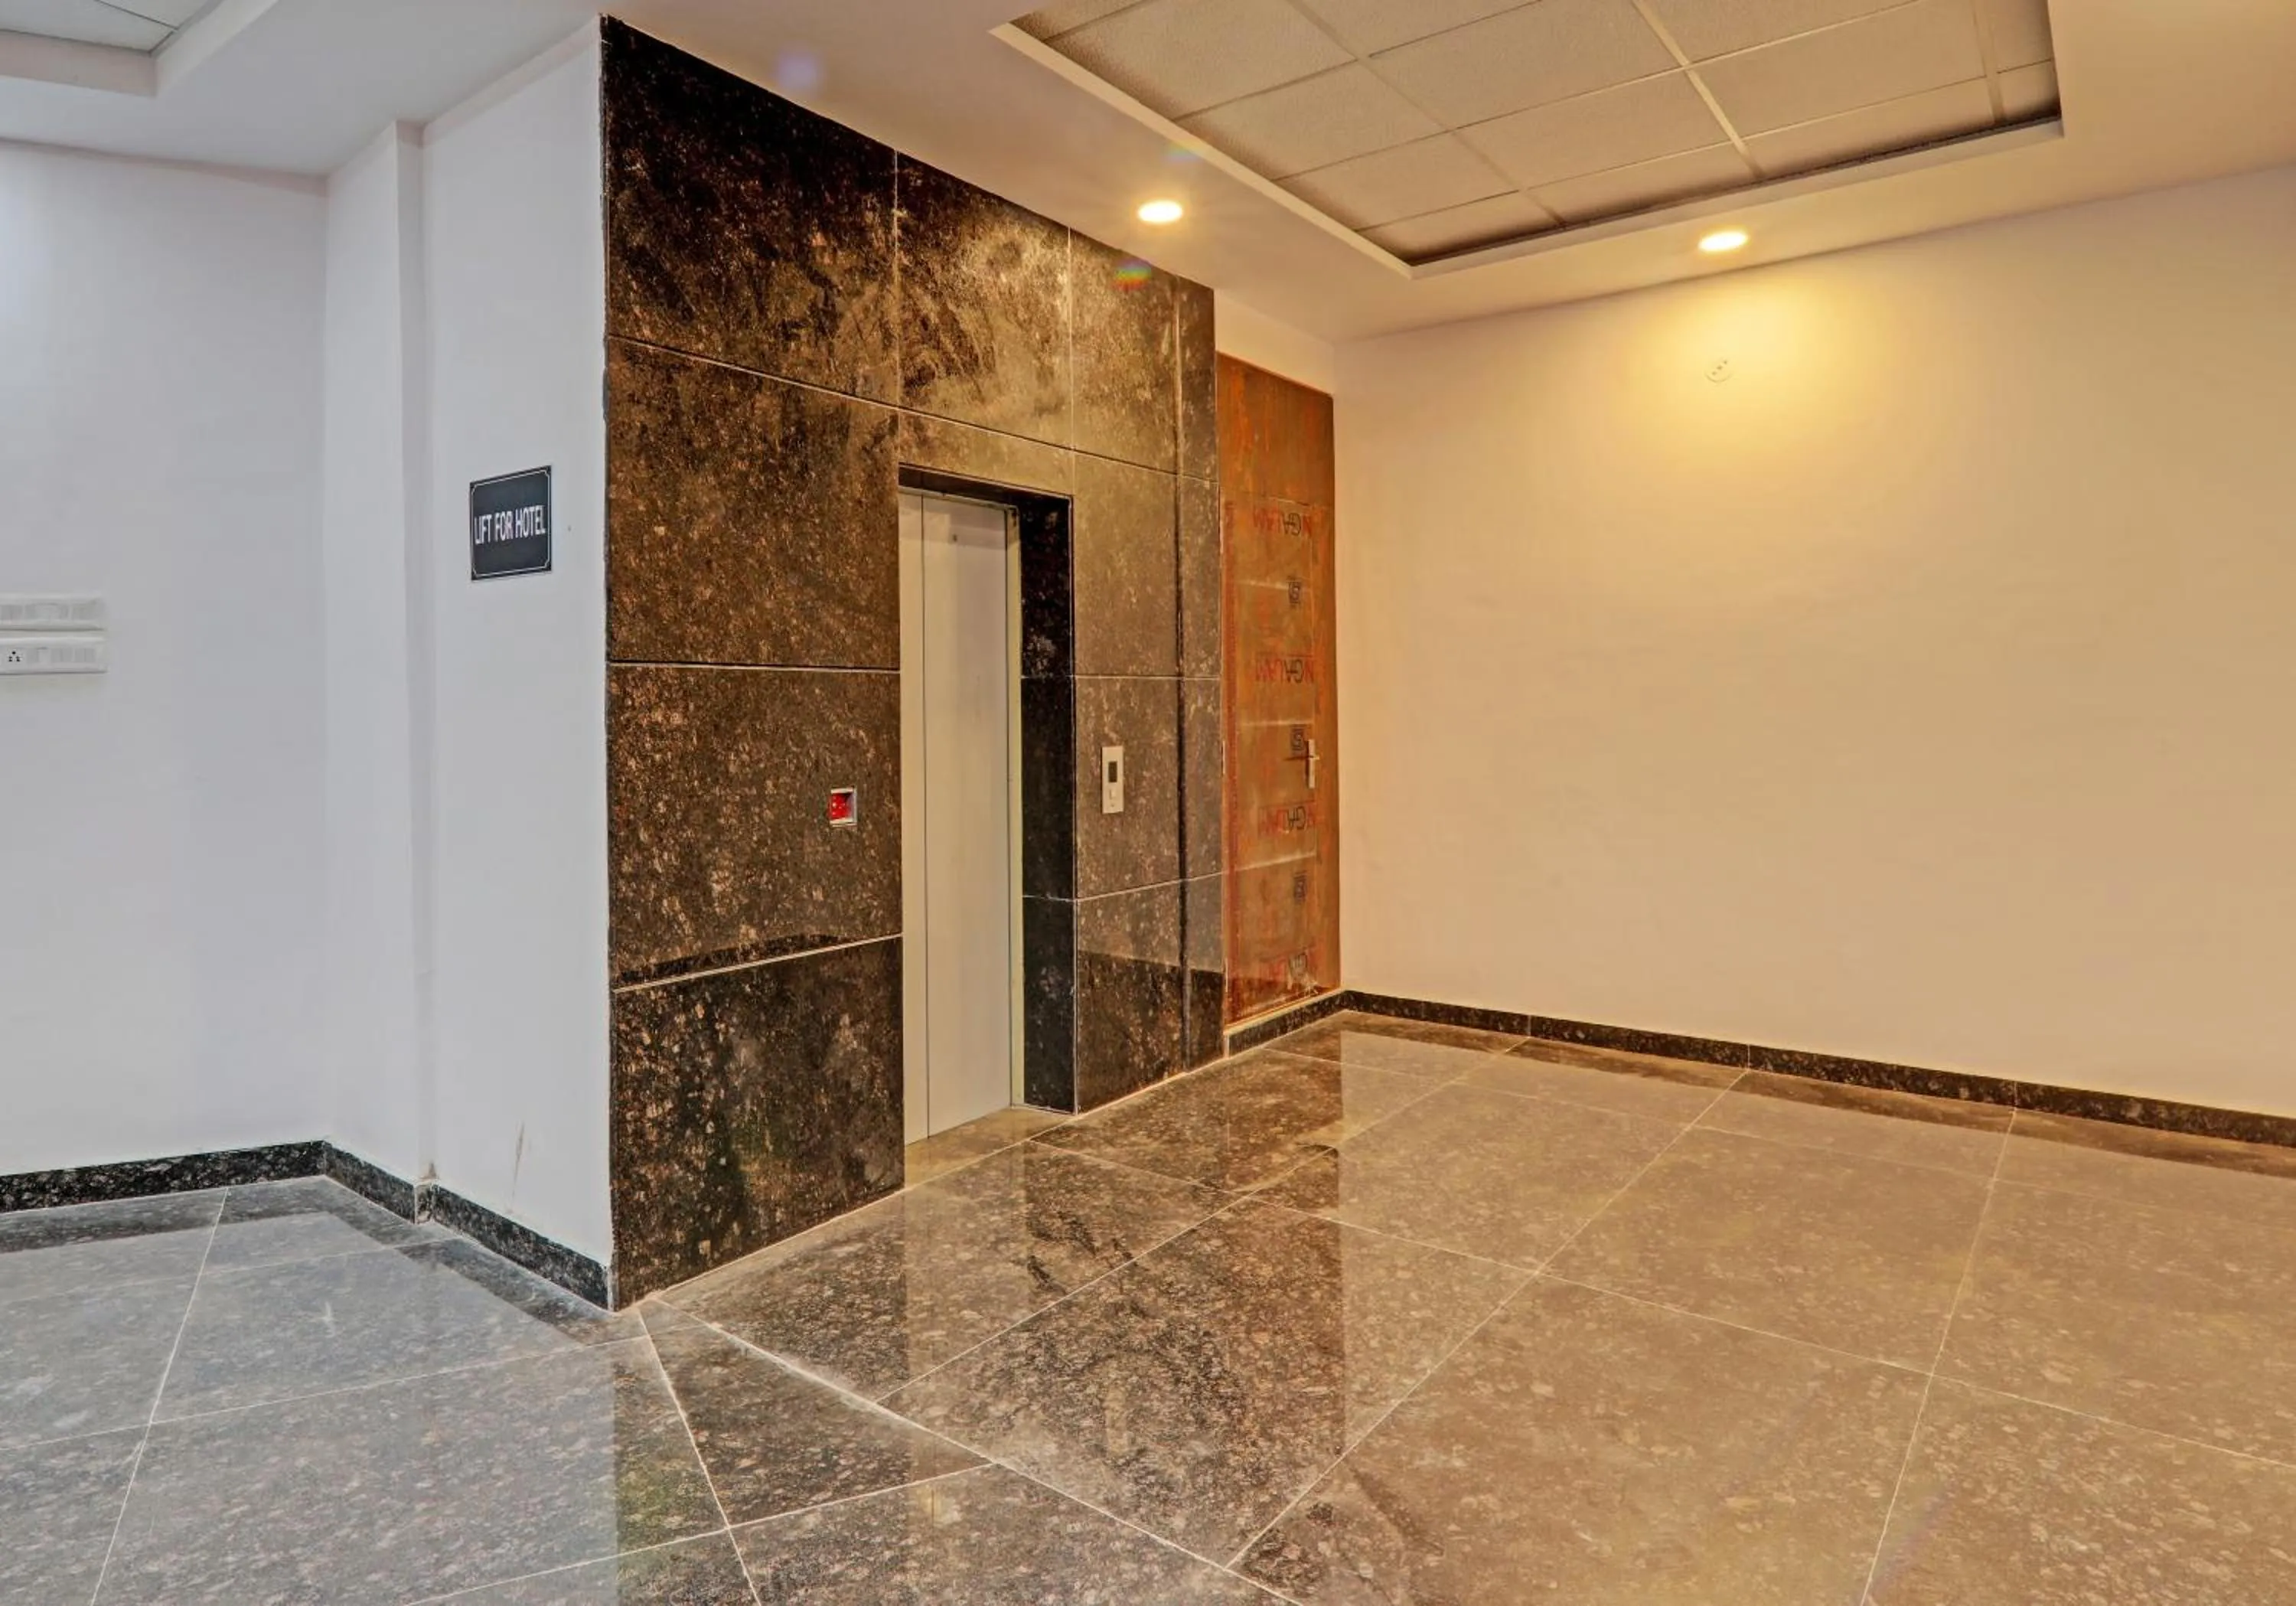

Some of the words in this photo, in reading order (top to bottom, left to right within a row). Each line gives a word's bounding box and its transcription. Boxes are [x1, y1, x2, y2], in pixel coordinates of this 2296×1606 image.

[474, 514, 492, 544] LIFT
[495, 511, 513, 541] FOR
[515, 505, 546, 537] HOTEL
